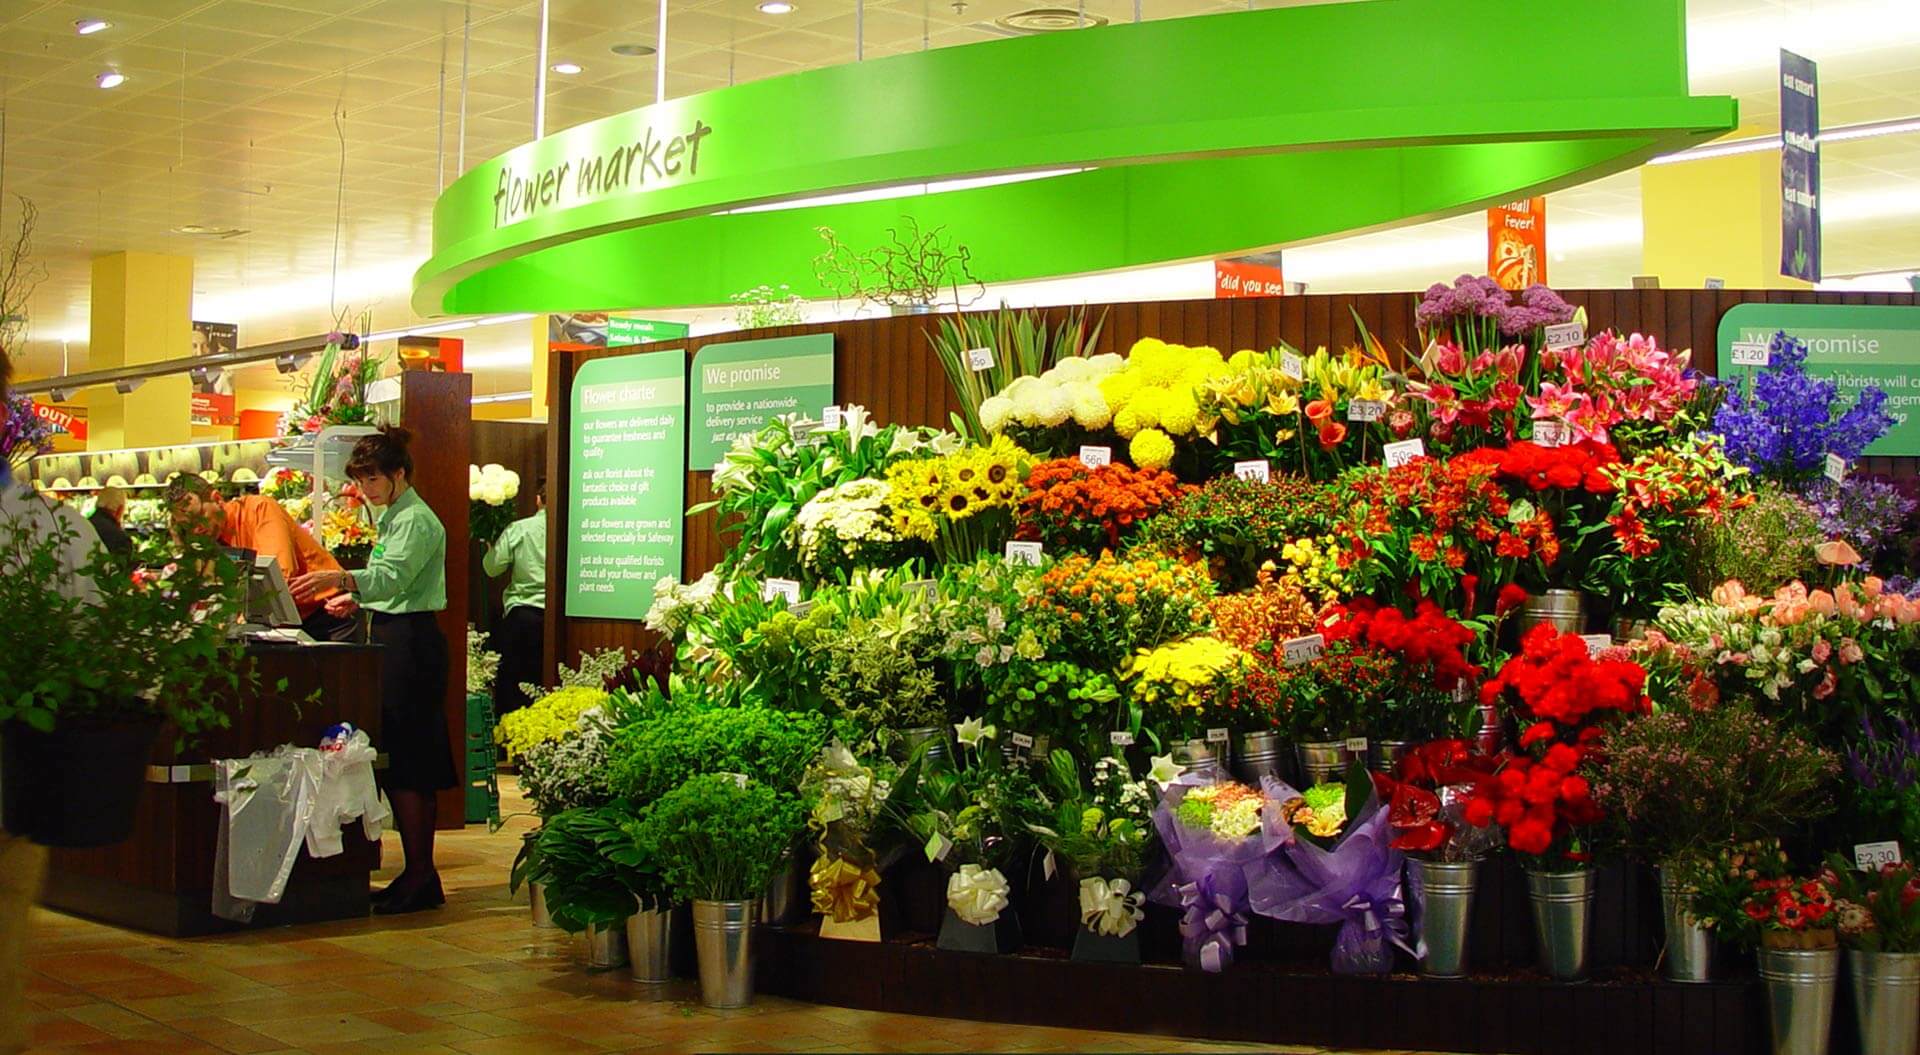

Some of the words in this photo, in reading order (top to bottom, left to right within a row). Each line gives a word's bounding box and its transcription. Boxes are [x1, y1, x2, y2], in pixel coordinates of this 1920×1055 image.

[1784, 73, 1794, 90] eat
[494, 161, 570, 229] flower
[577, 120, 712, 197] market
[1785, 187, 1796, 202] eat
[1504, 214, 1535, 230] Fever!
[1242, 280, 1262, 296] you
[1264, 281, 1282, 295] see
[1547, 331, 1580, 345] £2.10
[1731, 349, 1764, 360] £1.20
[706, 367, 727, 385] We
[729, 363, 781, 388] promise
[1837, 374, 1880, 388] florists
[1884, 374, 1907, 388] will
[584, 387, 616, 406] Flower
[619, 384, 657, 403] charter
[706, 402, 716, 413] to
[716, 400, 745, 414] provide
[746, 402, 751, 410] a
[753, 397, 797, 411] nationwide
[38, 406, 74, 428] OUT!
[583, 421, 595, 431] our
[595, 419, 618, 430] flowers
[629, 416, 658, 428] delivered
[659, 415, 675, 428] daily
[706, 416, 735, 430] delivery
[736, 414, 763, 425] service
[583, 433, 591, 443] to
[652, 429, 666, 441] and
[711, 431, 725, 444] just
[583, 446, 604, 459] quality
[593, 471, 605, 480] our
[623, 467, 642, 478] about
[643, 466, 655, 478] the
[608, 482, 629, 493] choice
[629, 482, 638, 492] of
[582, 497, 609, 509] products
[609, 495, 637, 506] available
[590, 520, 601, 529] our
[624, 520, 635, 529] are
[635, 520, 658, 531] grown
[657, 518, 672, 529] and
[581, 532, 606, 543] selected
[606, 532, 636, 545] especially
[636, 532, 647, 542] for
[648, 532, 674, 546] Safeway
[603, 556, 615, 565] our
[615, 554, 642, 568] qualified
[643, 554, 665, 566] florists
[580, 568, 598, 579] about
[607, 570, 622, 582] your
[622, 568, 642, 580] flower
[643, 570, 657, 580] and
[579, 582, 596, 594] plant
[596, 582, 615, 593] needs
[1286, 644, 1322, 662] £1.10
[1857, 849, 1896, 866] £2.30
